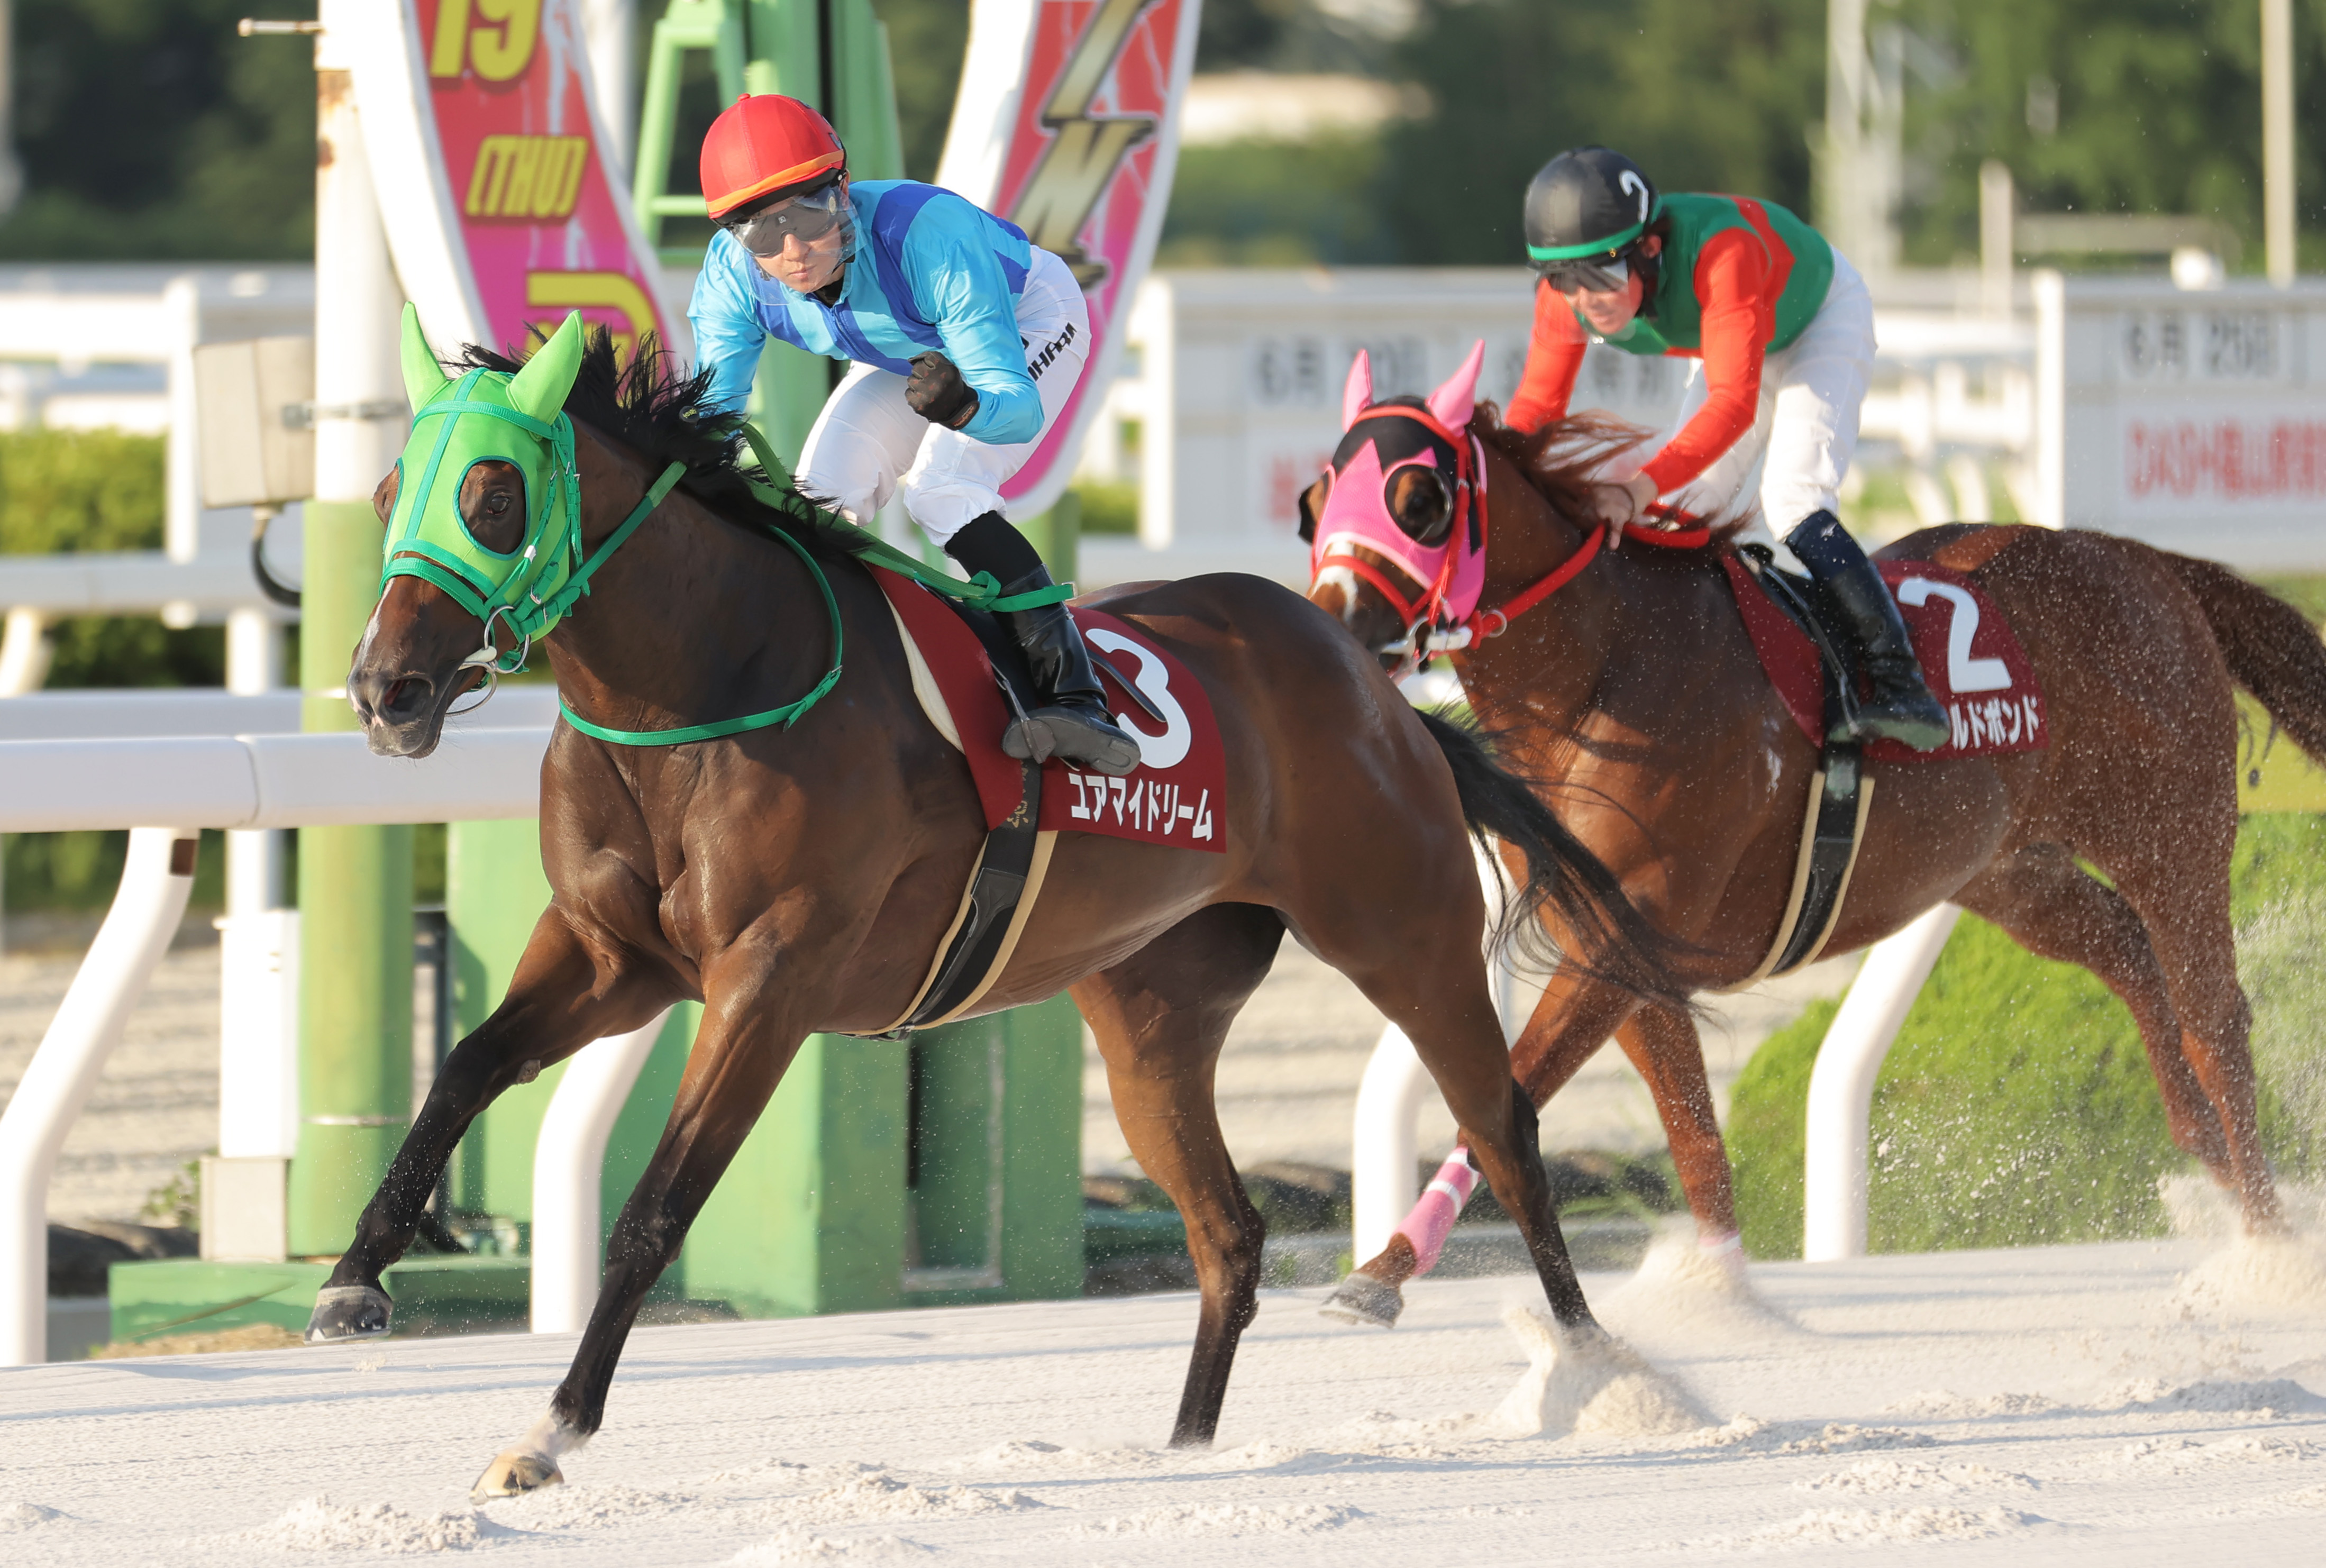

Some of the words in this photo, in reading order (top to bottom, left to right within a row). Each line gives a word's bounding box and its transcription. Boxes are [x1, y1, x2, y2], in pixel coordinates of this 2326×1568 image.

[1897, 576, 2012, 694] 2
[1086, 628, 1191, 769] 3
[1068, 772, 1213, 842] ユアマイドリーム
